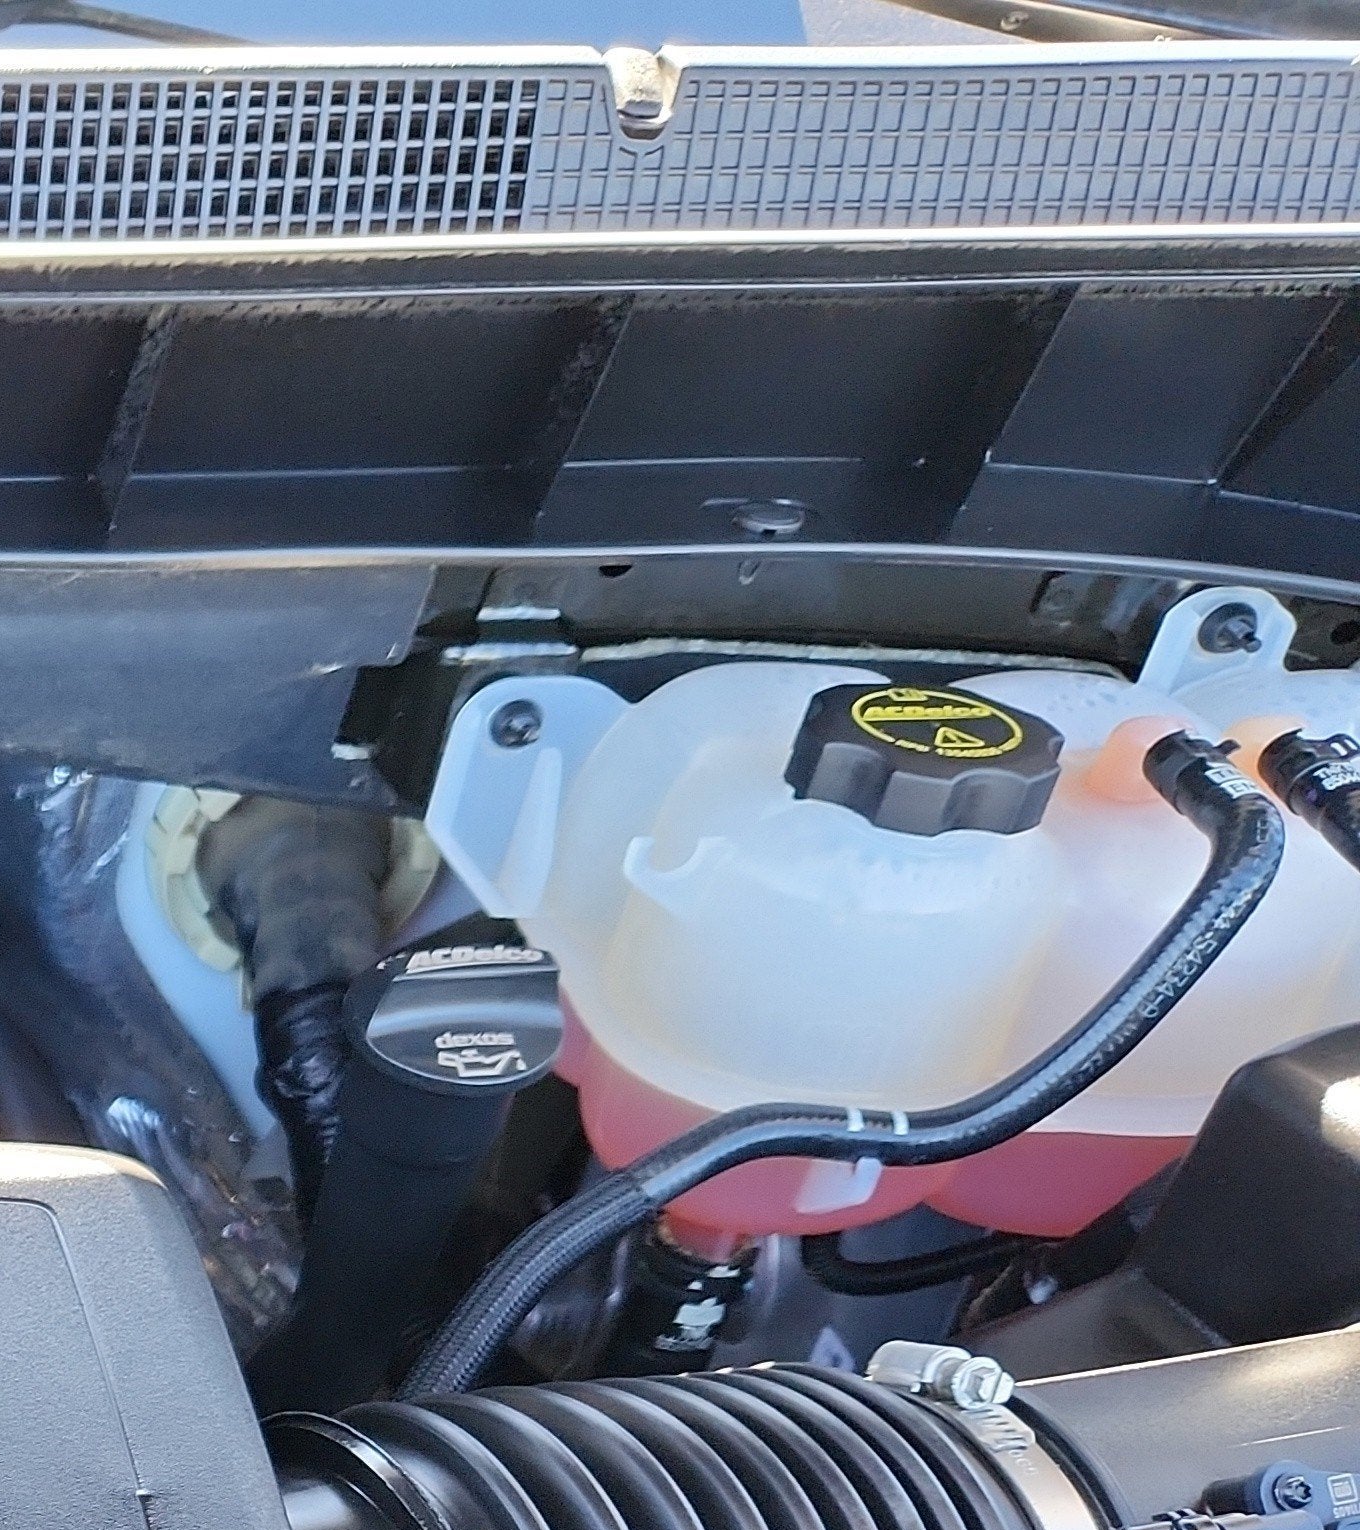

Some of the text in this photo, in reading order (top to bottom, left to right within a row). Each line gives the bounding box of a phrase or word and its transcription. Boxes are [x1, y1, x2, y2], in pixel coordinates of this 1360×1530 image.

[863, 705, 993, 721] ACDelco
[406, 945, 545, 972] ACDelco
[434, 1031, 516, 1049] dexos
